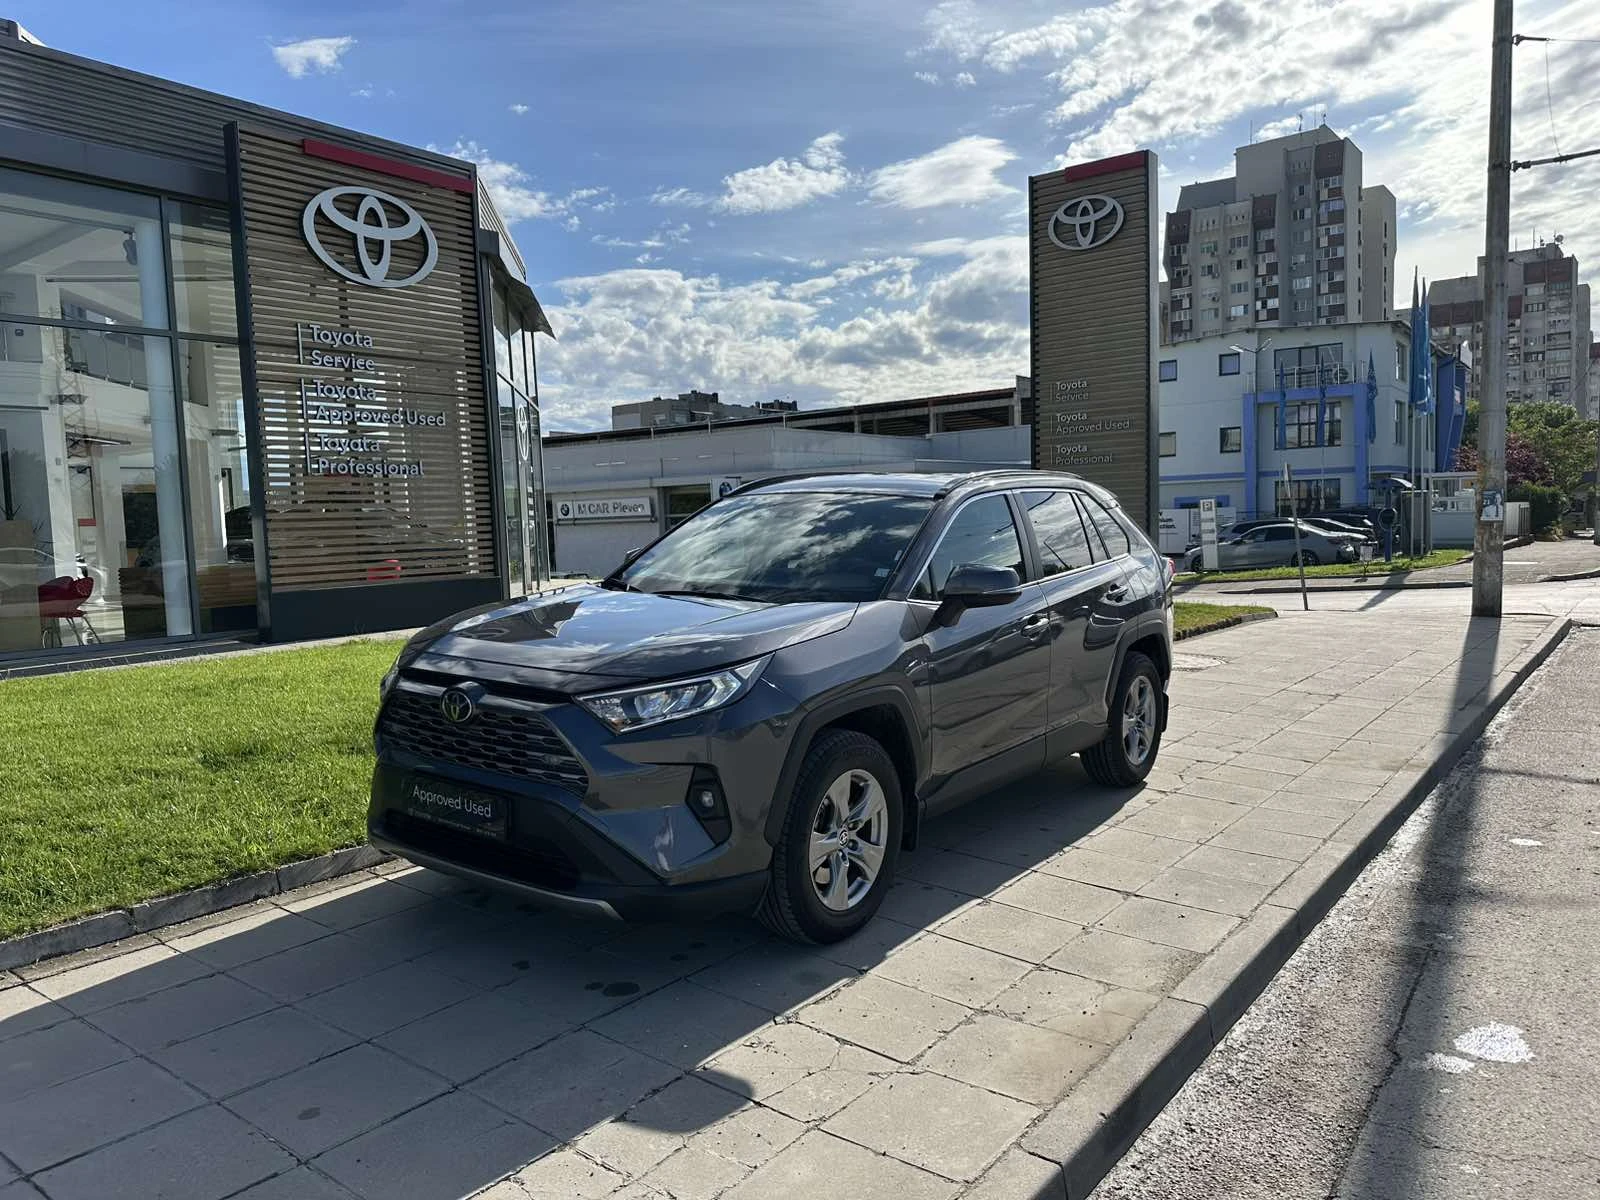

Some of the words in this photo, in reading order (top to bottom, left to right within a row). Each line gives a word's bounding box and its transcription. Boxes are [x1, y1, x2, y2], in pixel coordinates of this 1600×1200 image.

[309, 324, 374, 348] Toyota
[311, 350, 376, 371] Service
[313, 379, 376, 401] Toyota
[1055, 380, 1088, 391] Toyota
[1055, 392, 1089, 402] Service
[316, 405, 401, 425] Approved
[406, 409, 446, 427] Used
[1055, 412, 1088, 423] Toyota
[1055, 422, 1102, 435] Approved
[1104, 419, 1130, 431] Used
[317, 433, 381, 454] Toyota
[1055, 444, 1088, 455] Toyota
[318, 457, 425, 476] Professional
[1055, 453, 1113, 465] Professional
[612, 502, 645, 514] Pleven
[412, 785, 461, 809] Approved
[464, 799, 491, 818] Used
